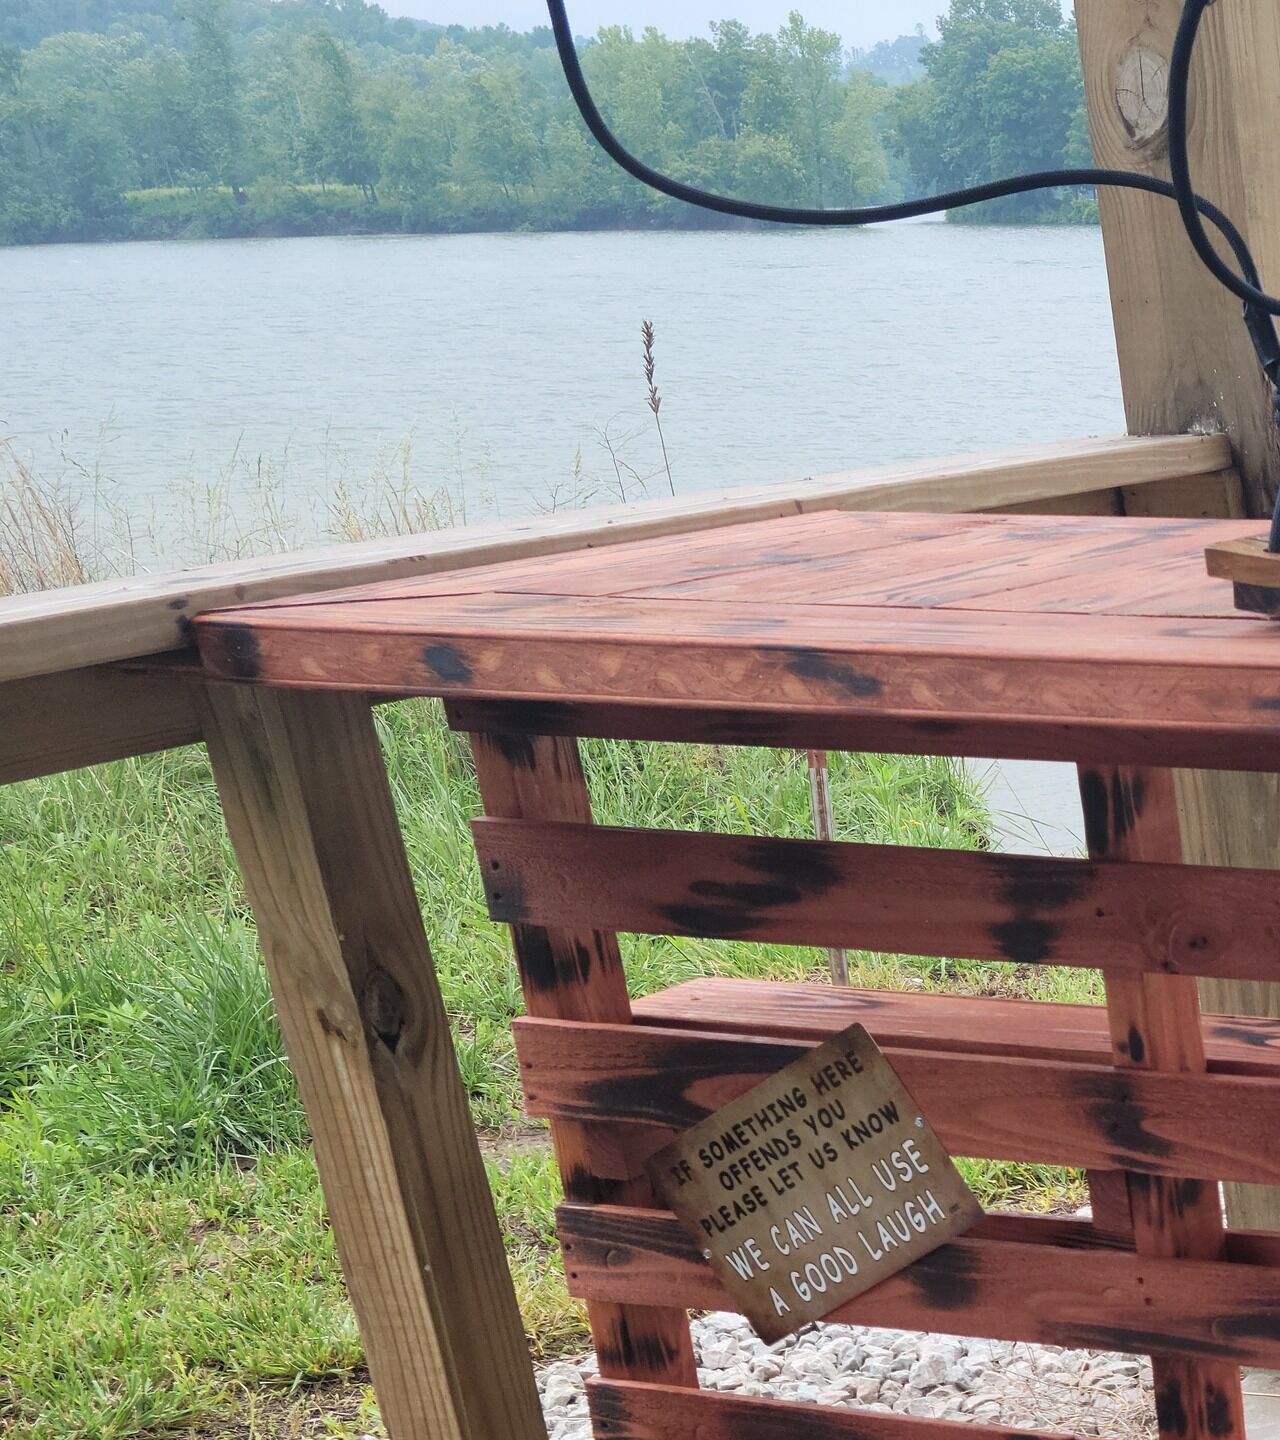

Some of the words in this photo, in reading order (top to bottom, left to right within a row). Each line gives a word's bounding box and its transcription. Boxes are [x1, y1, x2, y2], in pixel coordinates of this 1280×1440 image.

[671, 1160, 694, 1186] IF
[698, 1087, 807, 1169] SOMETHING
[811, 1051, 864, 1096] HERE
[701, 1186, 768, 1238] PLEASE
[768, 1162, 805, 1196] LET
[808, 1143, 838, 1169] US
[841, 1101, 900, 1150] KNOW
[719, 1131, 800, 1190] OFFENDS
[804, 1100, 845, 1136] YOU
[725, 1238, 770, 1281] WE
[770, 1206, 822, 1255] CAN
[826, 1178, 873, 1224] ALL
[872, 1139, 928, 1191] USE
[770, 1287, 790, 1316] A
[790, 1246, 858, 1301] GOOD
[858, 1189, 946, 1261] LAUGH
